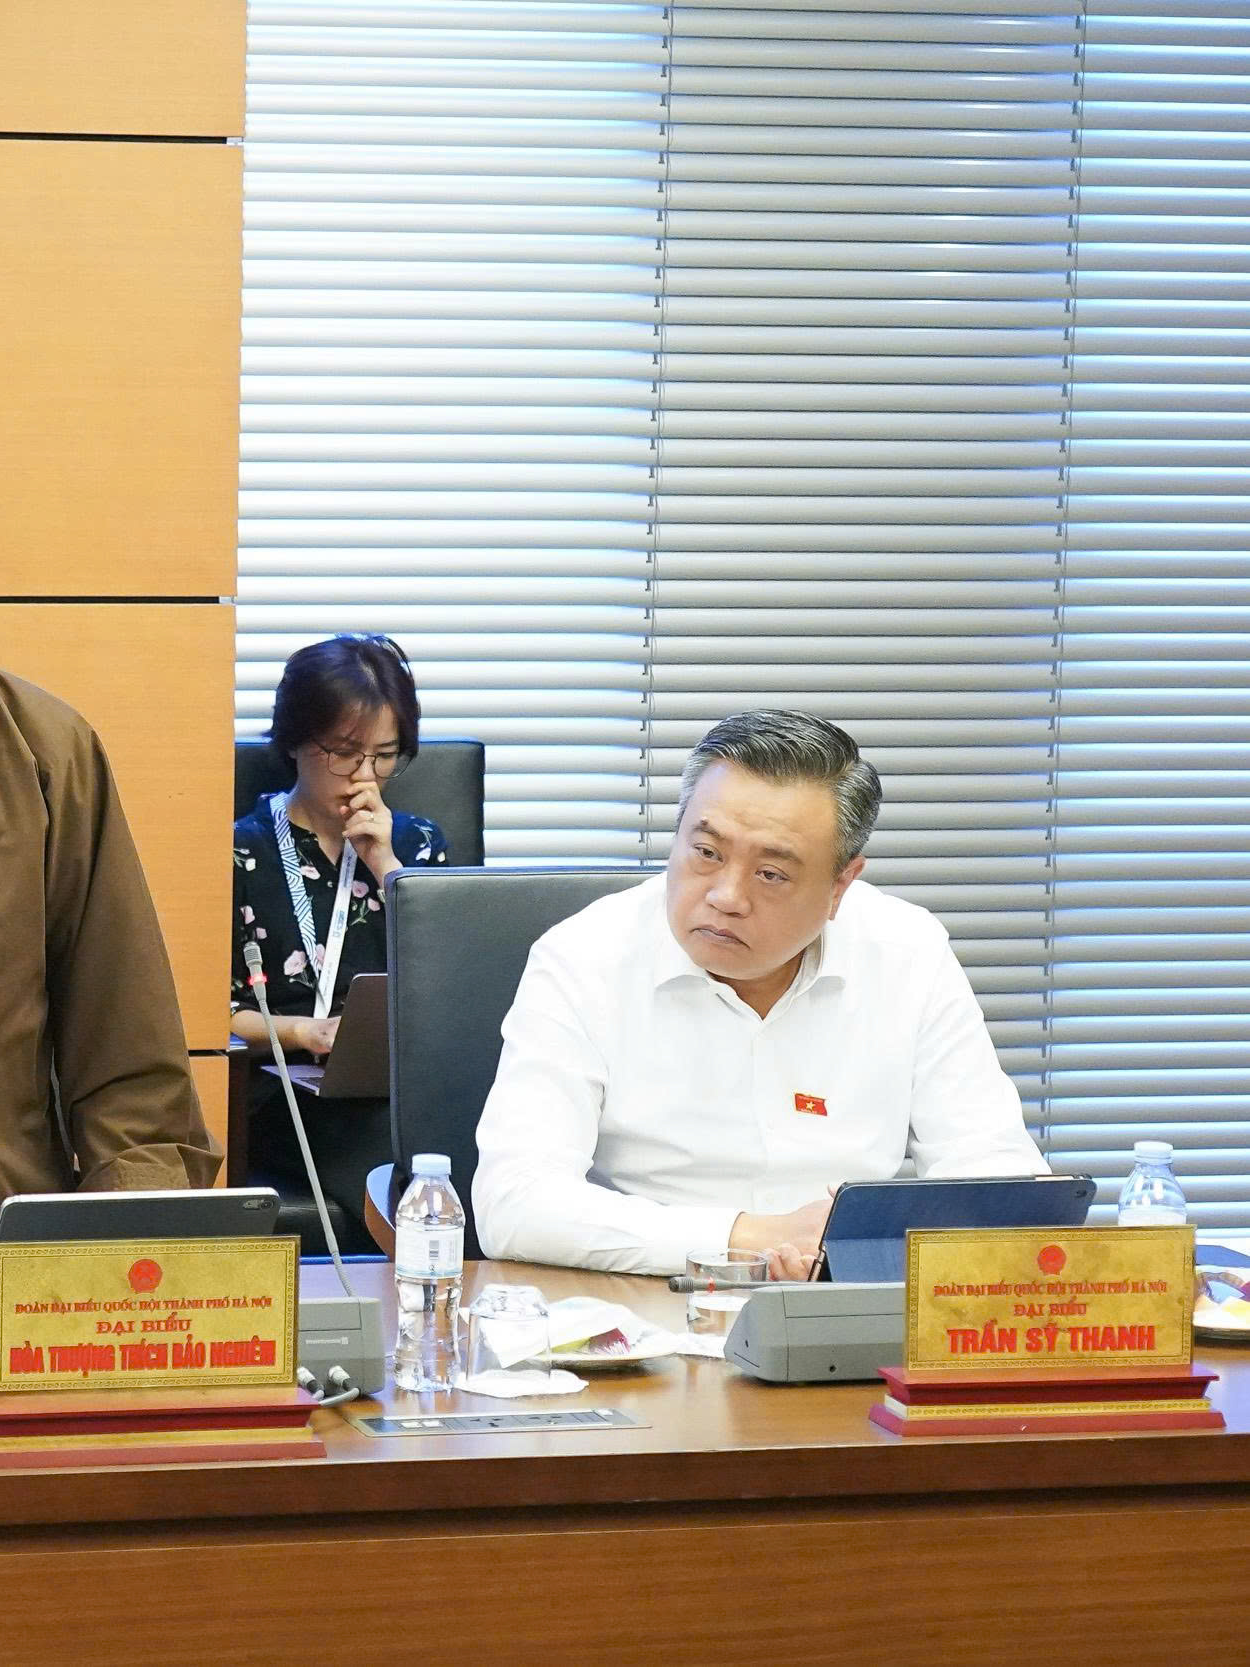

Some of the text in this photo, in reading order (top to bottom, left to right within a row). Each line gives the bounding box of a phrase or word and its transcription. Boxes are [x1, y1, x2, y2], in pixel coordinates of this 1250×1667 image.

[14, 1301, 49, 1314] ĐOÀN
[50, 1302, 72, 1314] ĐẠI
[103, 1297, 137, 1313] QUỐC
[232, 1296, 249, 1308] HÀ
[1014, 1303, 1045, 1318] ĐẠI
[95, 1311, 192, 1336] ĐẠI BIỂU
[947, 1318, 1155, 1353] TRẦN SỸ THANH
